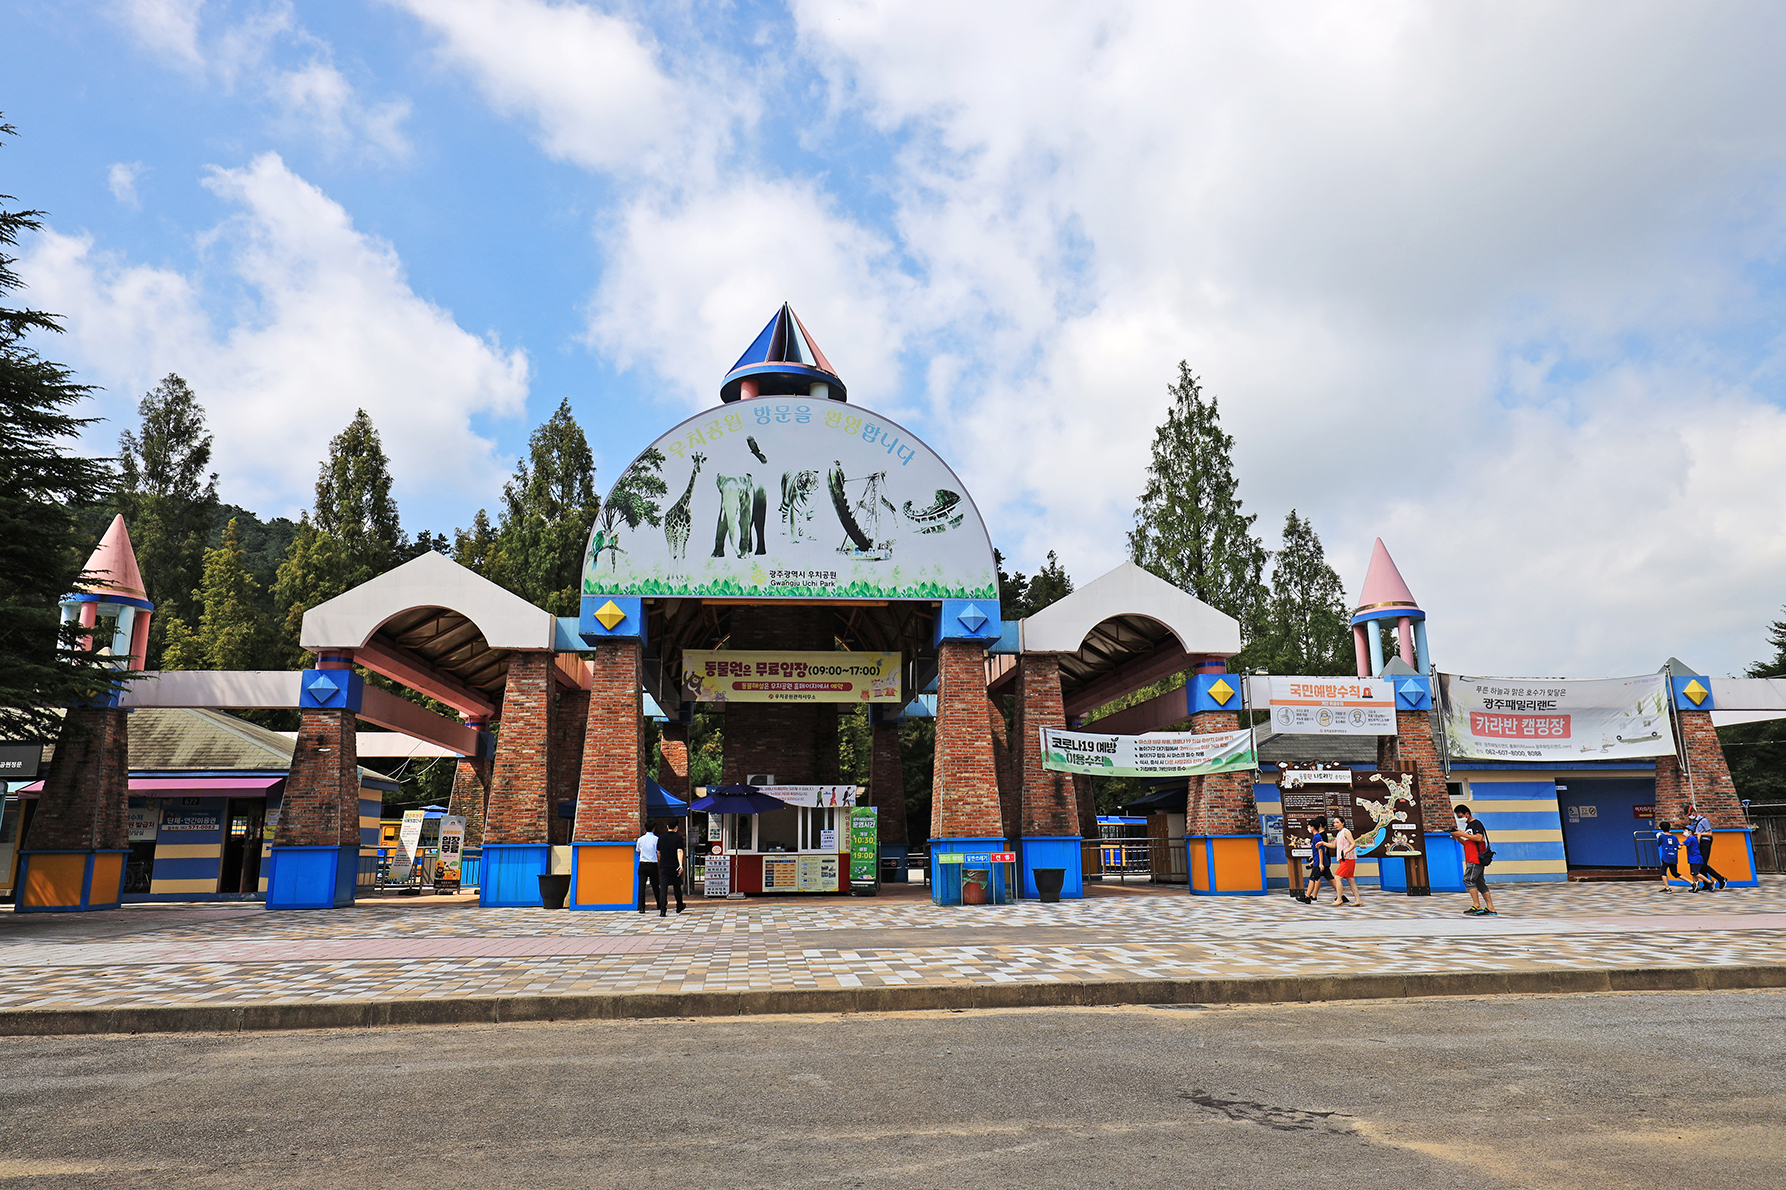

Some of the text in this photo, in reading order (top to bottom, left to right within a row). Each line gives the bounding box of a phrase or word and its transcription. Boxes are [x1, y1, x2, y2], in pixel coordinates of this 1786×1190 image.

[668, 405, 917, 466] 우치공원 방문을 환영합니다
[769, 570, 837, 580] 광주광역시 우치공원
[770, 579, 801, 588] Gwangju
[704, 660, 752, 678] 동물원은
[771, 682, 793, 691] 우치공원
[794, 682, 830, 690] 홈페이지에서
[830, 683, 845, 691] 예약
[1289, 683, 1361, 699] 국민예방수칙
[1475, 685, 1567, 698] 푸른 하늘과 맑은 호수가 맞닿은
[1482, 698, 1558, 712] 광주패밀리랜드
[1476, 715, 1566, 736] 카라반 캠핑장
[1052, 737, 1119, 754] 코로나19 예방
[1065, 750, 1105, 767] 이용수칙
[136, 821, 155, 829] 발급처
[442, 836, 461, 846] 입장
[854, 836, 875, 844] 10:30
[441, 845, 460, 854] 무료
[853, 852, 875, 860] 19:00
